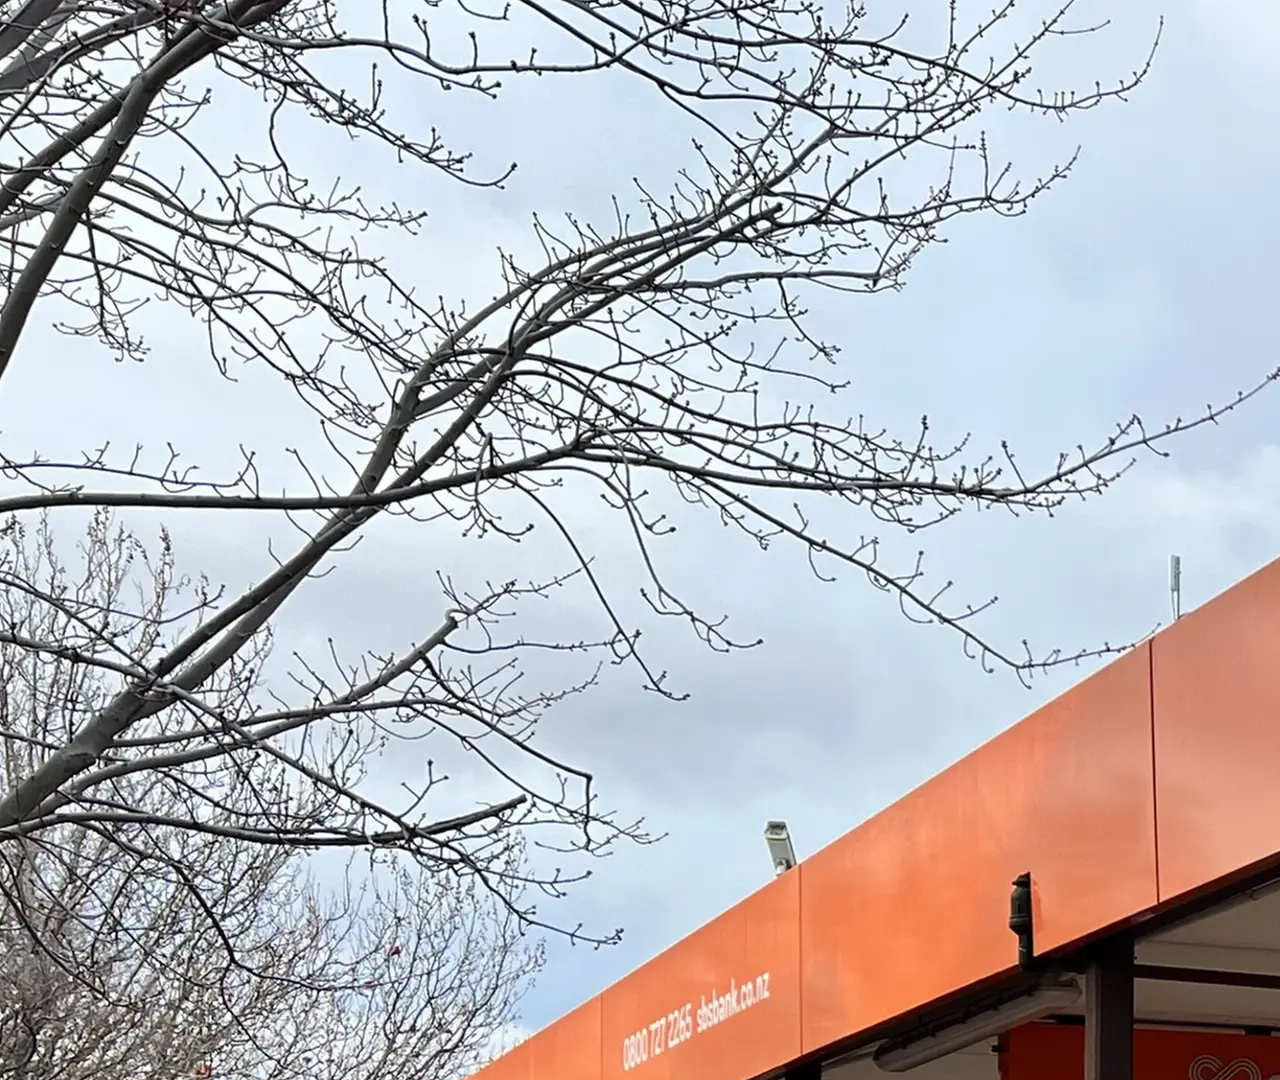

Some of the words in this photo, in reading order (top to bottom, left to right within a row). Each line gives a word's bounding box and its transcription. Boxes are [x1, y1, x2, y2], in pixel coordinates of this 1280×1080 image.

[623, 1027, 648, 1071] 0800
[649, 1017, 666, 1058] 727
[667, 1003, 692, 1048] 2265
[696, 972, 770, 1033] sbsbank.co.nz
